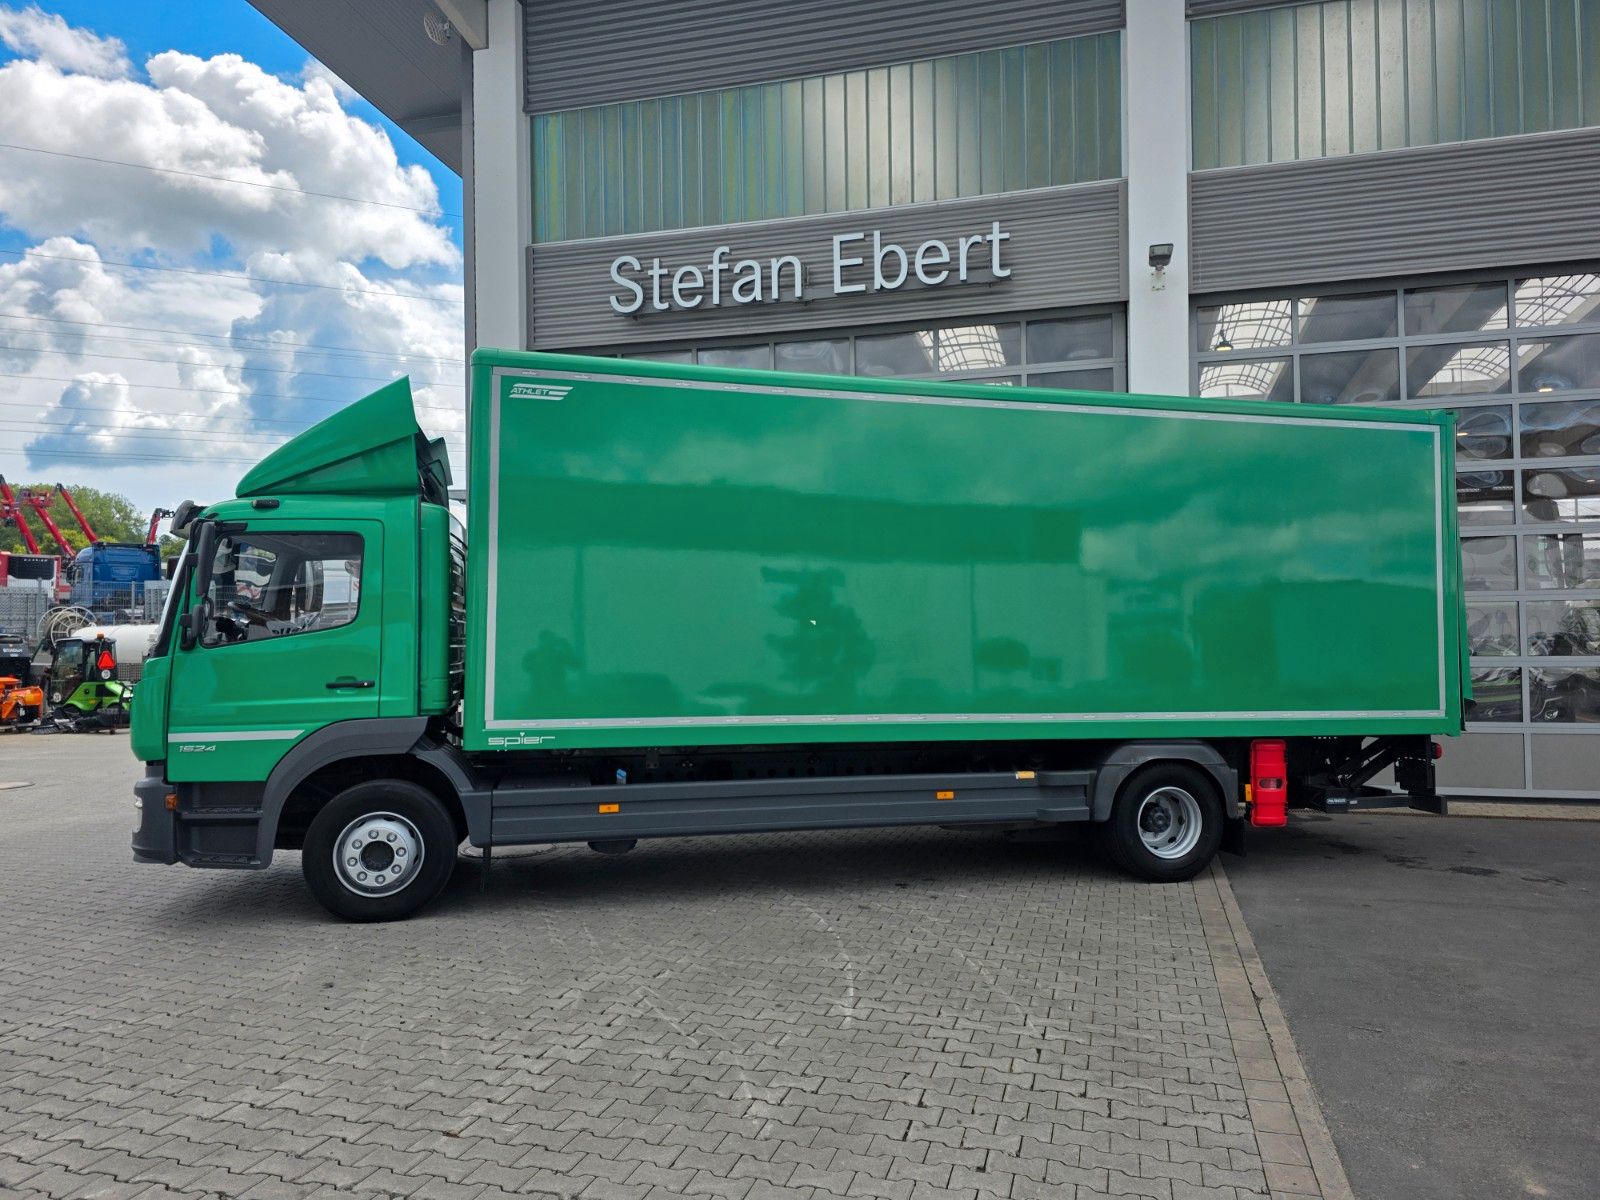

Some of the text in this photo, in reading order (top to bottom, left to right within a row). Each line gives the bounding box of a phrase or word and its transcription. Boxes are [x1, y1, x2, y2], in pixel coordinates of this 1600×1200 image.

[609, 221, 1012, 315] Stefan Ebert
[510, 387, 549, 396] ATHLET
[488, 732, 556, 748] spier
